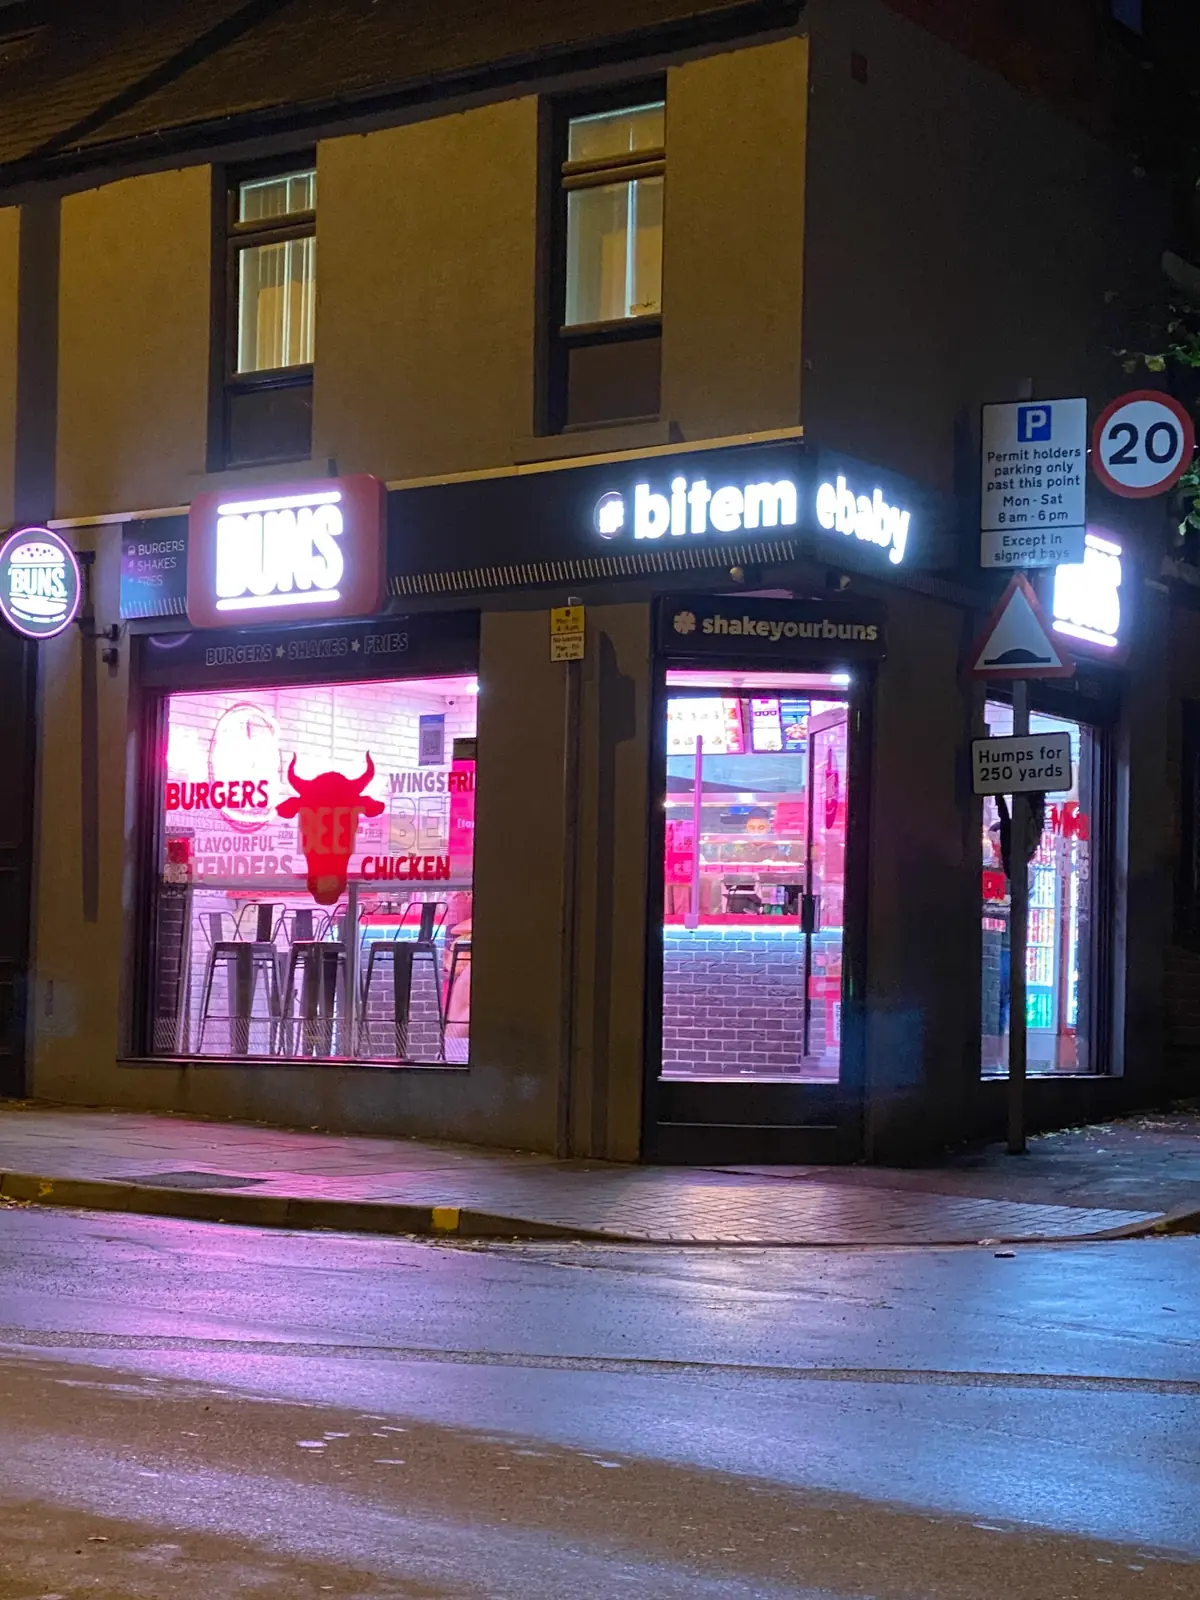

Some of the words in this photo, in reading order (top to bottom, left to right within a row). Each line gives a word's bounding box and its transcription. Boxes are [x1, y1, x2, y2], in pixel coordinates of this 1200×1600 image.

[1025, 410, 1047, 439] P
[1108, 421, 1178, 465] 20
[987, 450, 1029, 463] Permit
[1034, 448, 1081, 459] holders
[995, 466, 1042, 476] parking
[1046, 462, 1074, 474] only
[987, 480, 1014, 491] past
[1019, 477, 1042, 488] this
[1047, 474, 1080, 488] point
[1003, 496, 1030, 507] Mon
[1041, 494, 1063, 505] Sat
[634, 476, 798, 539] bitem
[816, 475, 910, 565] ebaby
[999, 512, 1005, 523] 8
[1009, 514, 1028, 522] am
[1039, 510, 1046, 521] 6
[1049, 511, 1069, 523] pm
[138, 540, 185, 556] BURGERS
[1002, 535, 1046, 548] Except
[1050, 533, 1062, 544] in
[216, 504, 344, 598] BUNS
[994, 552, 1036, 563] signed
[138, 557, 177, 572] SHAKES
[206, 644, 273, 666] BURGERS
[288, 637, 348, 660] SHAKES
[363, 633, 409, 654] FRIES
[979, 749, 1034, 763] Humps
[1040, 746, 1063, 760] for
[980, 766, 1013, 781] 250
[1019, 764, 1064, 781] yards
[389, 771, 446, 793] WINGS
[165, 780, 269, 810] BURGERS
[189, 855, 294, 880] TENDERS
[361, 856, 451, 880] CHICKEN
